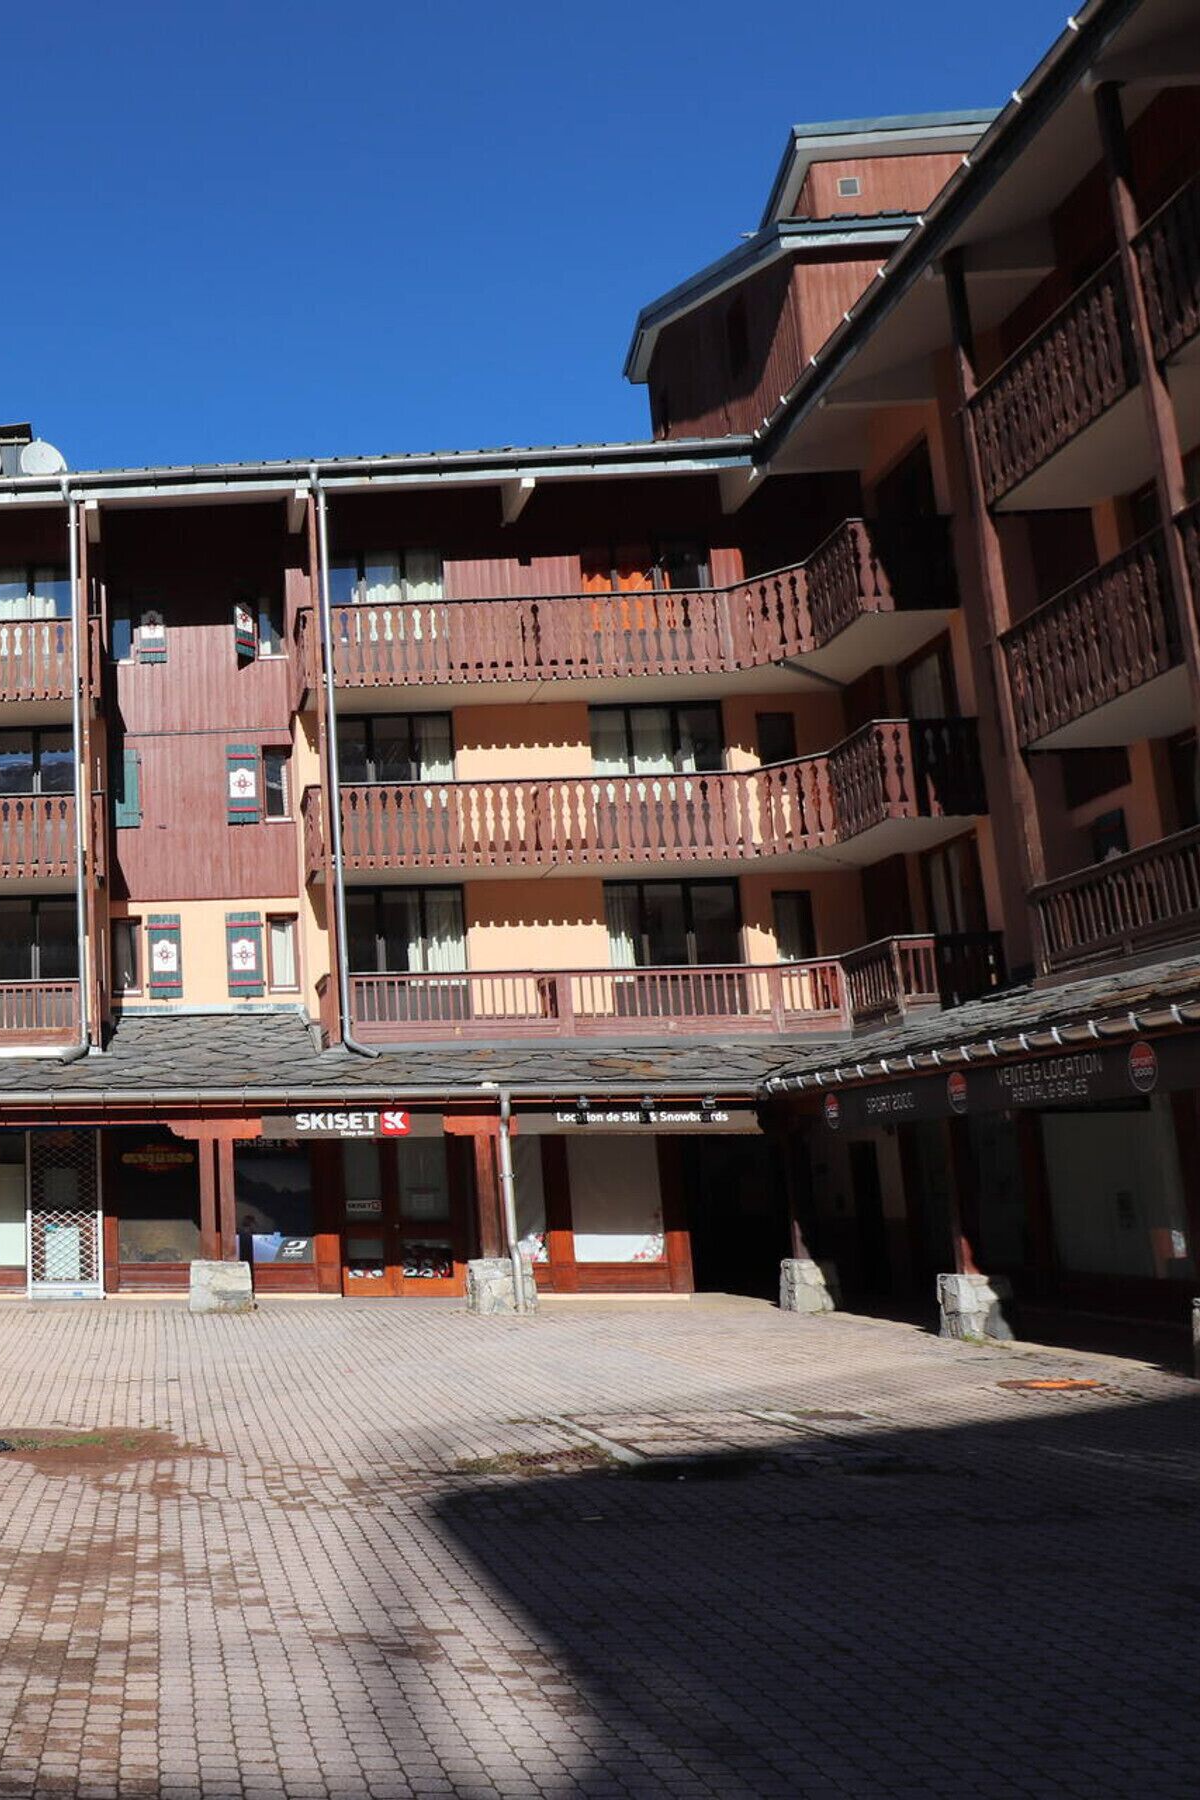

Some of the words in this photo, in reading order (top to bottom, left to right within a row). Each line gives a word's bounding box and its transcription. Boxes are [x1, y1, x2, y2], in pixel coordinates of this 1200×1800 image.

[1041, 1054, 1103, 1080] LOCATION
[295, 1112, 378, 1131] SKISET
[606, 1111, 619, 1123] de
[649, 1112, 657, 1122] &
